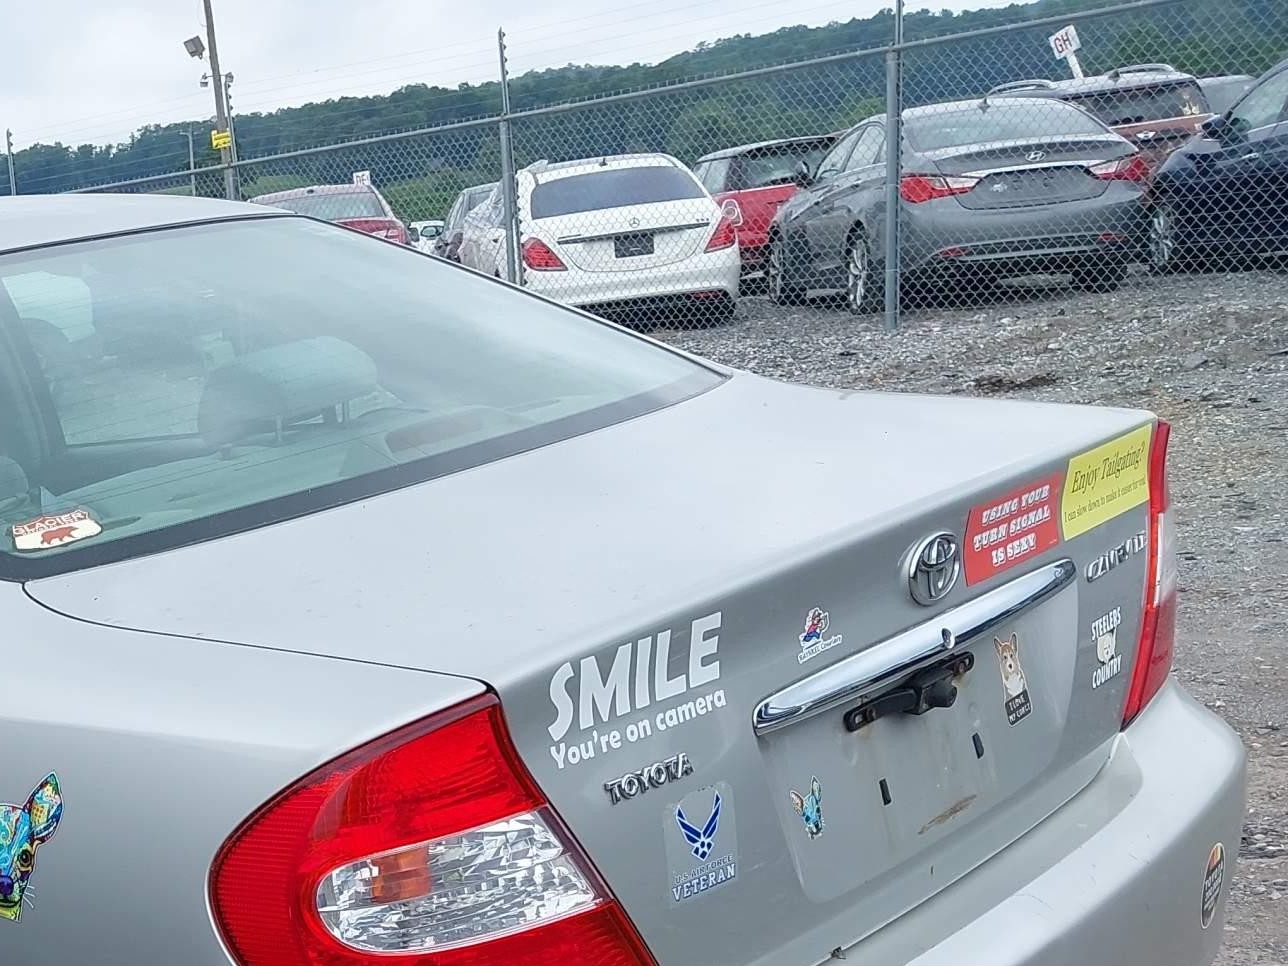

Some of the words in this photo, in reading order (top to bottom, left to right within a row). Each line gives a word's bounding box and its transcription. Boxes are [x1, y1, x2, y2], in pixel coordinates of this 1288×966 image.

[1055, 31, 1073, 54] GH
[1072, 464, 1101, 494] Enjoy
[1101, 441, 1146, 478] Tailgating?
[13, 511, 88, 536] GLACIER
[982, 498, 1019, 526] USING
[1021, 484, 1050, 510] YOUR
[974, 523, 1008, 552] TURN
[1010, 504, 1051, 536] SIGNAL
[992, 547, 1006, 567] IS
[1006, 533, 1036, 560] SEXY
[1091, 606, 1121, 641] STEELERS
[547, 611, 722, 742] SMILE
[1092, 654, 1122, 690] COUNTRY
[550, 730, 622, 769] You're
[626, 718, 652, 743] on
[656, 689, 727, 731] camera
[604, 752, 694, 805] TOYOTA
[672, 863, 736, 902] VETERAN
[691, 865, 705, 878] AIR
[706, 854, 733, 872] FORCE
